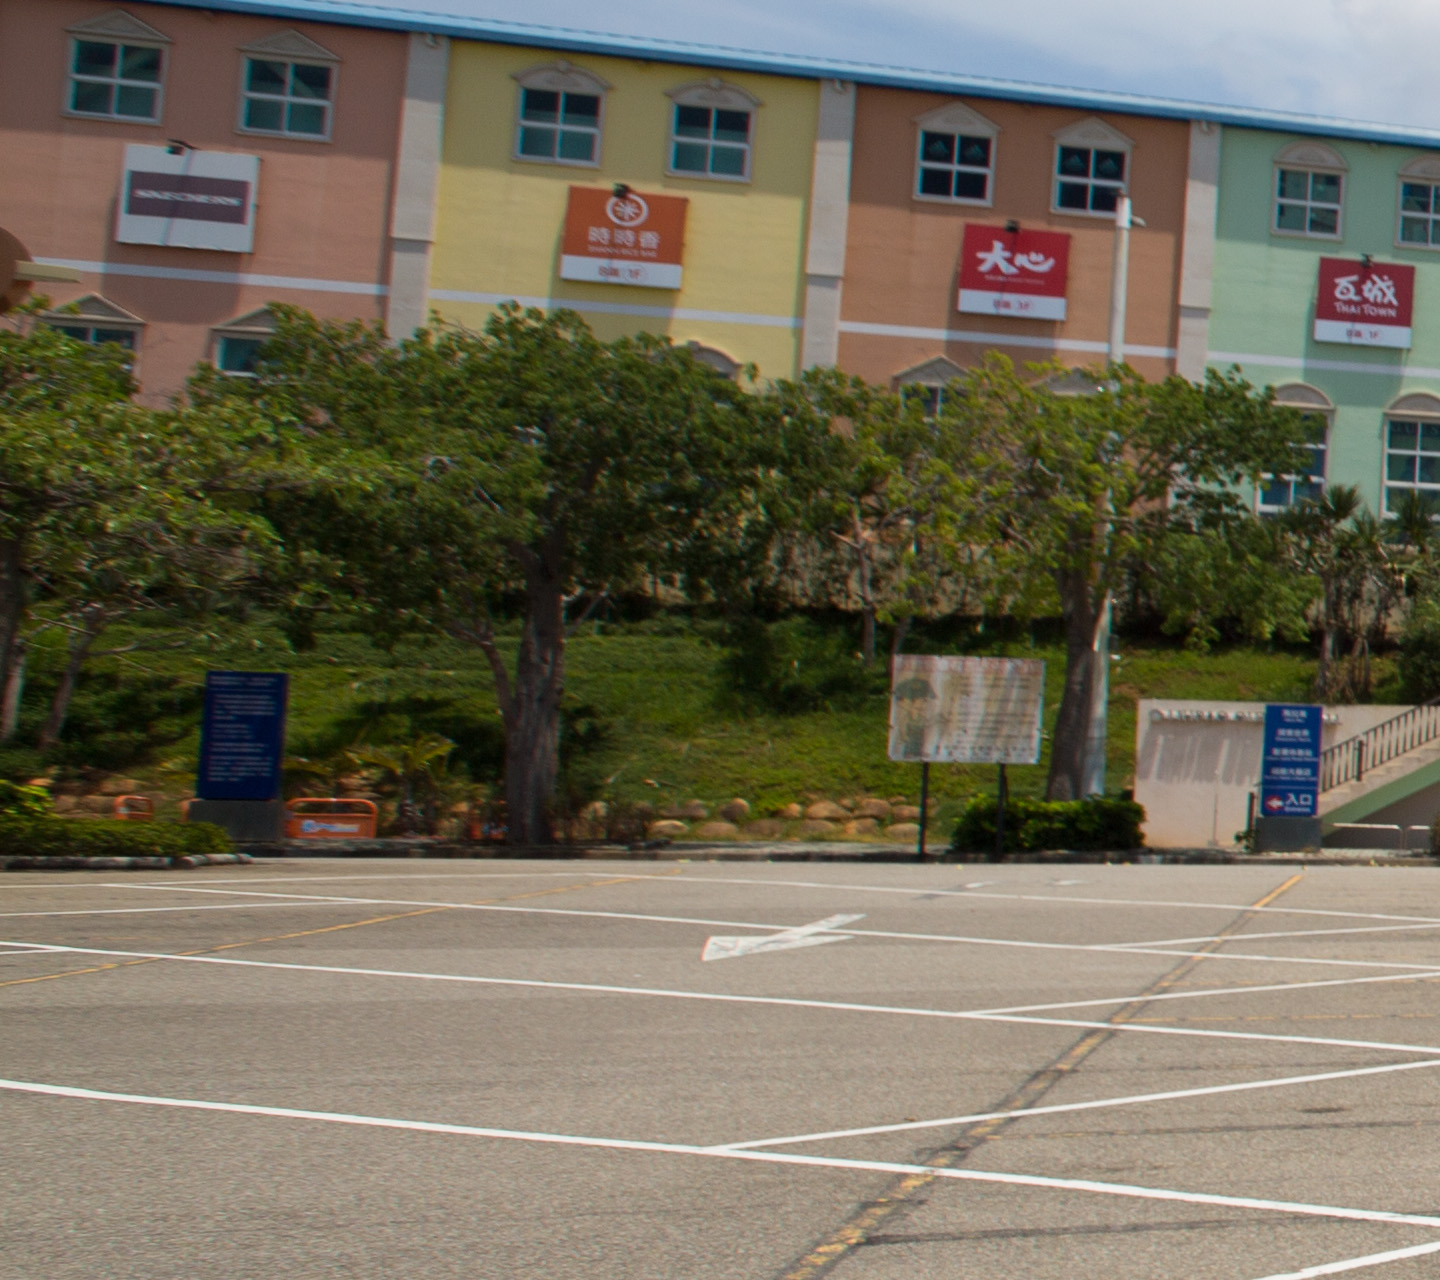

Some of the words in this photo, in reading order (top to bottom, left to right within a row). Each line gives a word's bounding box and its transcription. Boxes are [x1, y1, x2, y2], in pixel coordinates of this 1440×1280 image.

[976, 240, 1056, 275] 大心
[1334, 274, 1399, 306] 瓦城
[1362, 304, 1397, 317] TOWN
[1286, 792, 1312, 806] 入口
